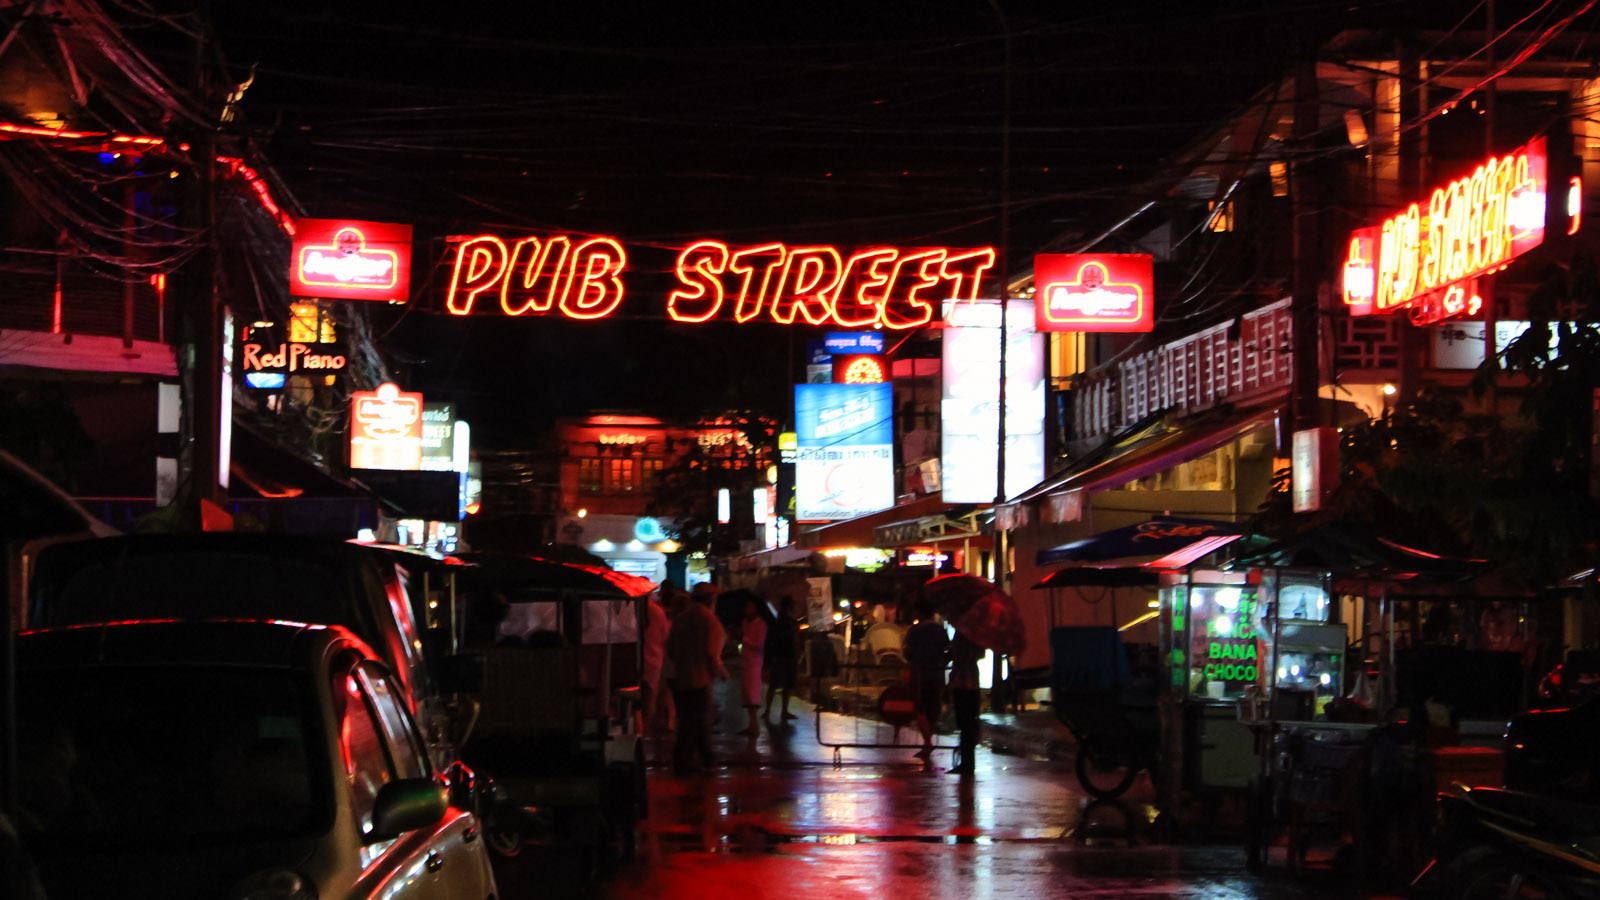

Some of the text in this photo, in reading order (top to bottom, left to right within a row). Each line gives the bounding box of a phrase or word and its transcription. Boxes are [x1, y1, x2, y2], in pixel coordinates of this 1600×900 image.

[447, 235, 996, 330] PUB STREET
[243, 343, 347, 372] Red Piano
